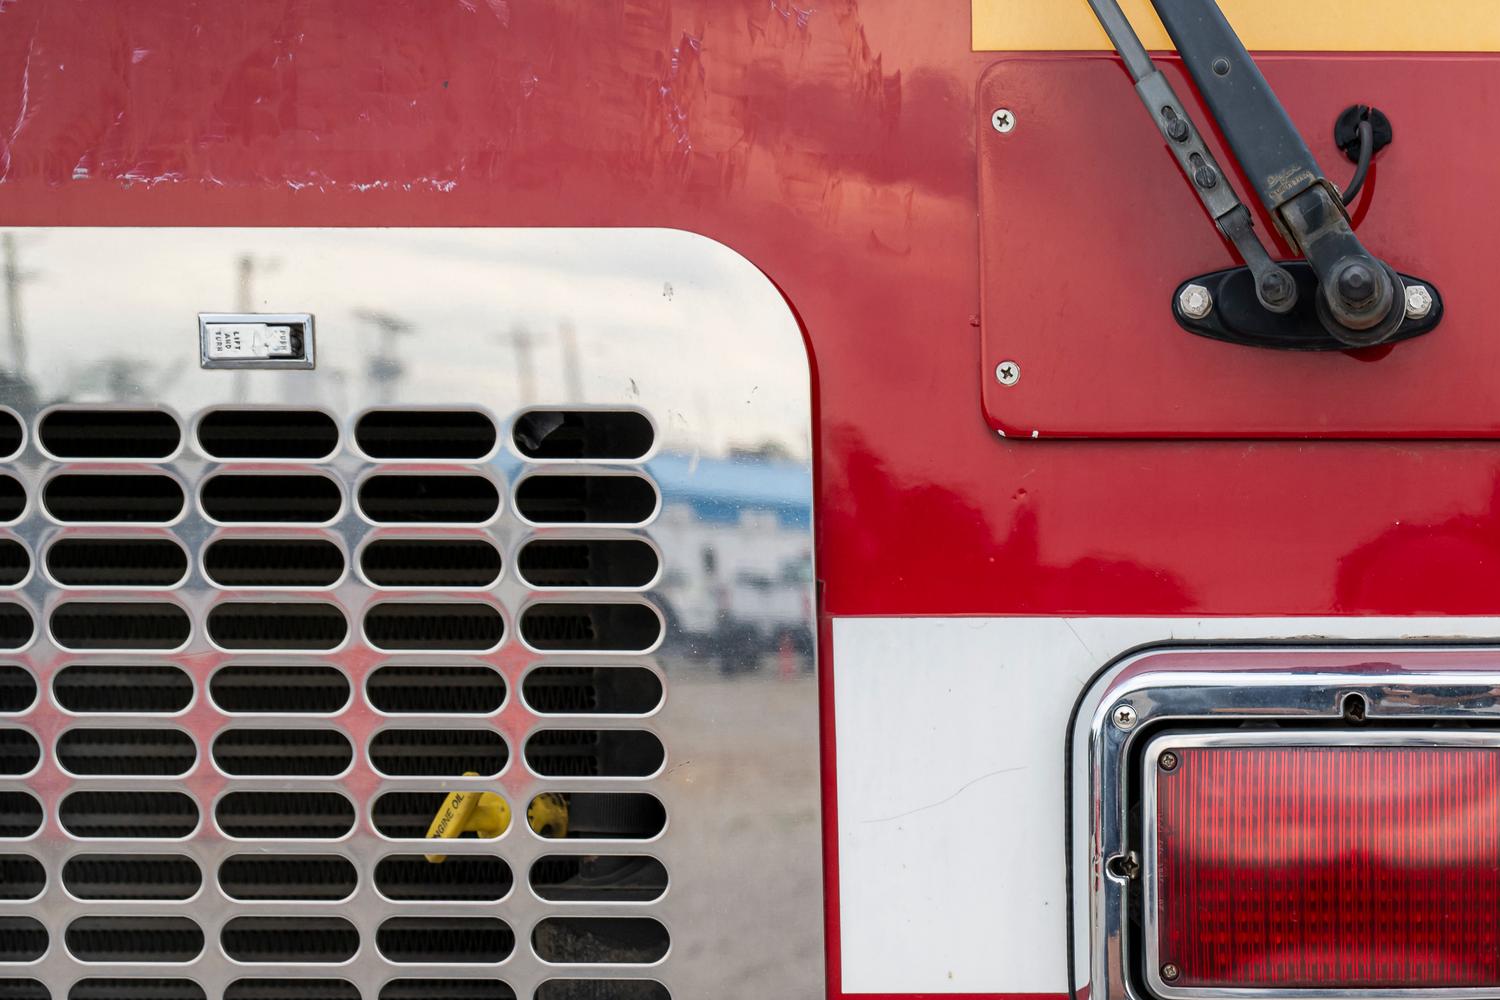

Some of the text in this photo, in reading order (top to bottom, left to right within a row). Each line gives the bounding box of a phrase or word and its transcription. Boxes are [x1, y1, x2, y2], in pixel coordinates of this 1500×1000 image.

[215, 331, 223, 352] TURN
[224, 333, 232, 350] AND
[233, 331, 241, 350] LIFT
[452, 793, 465, 809] OIL
